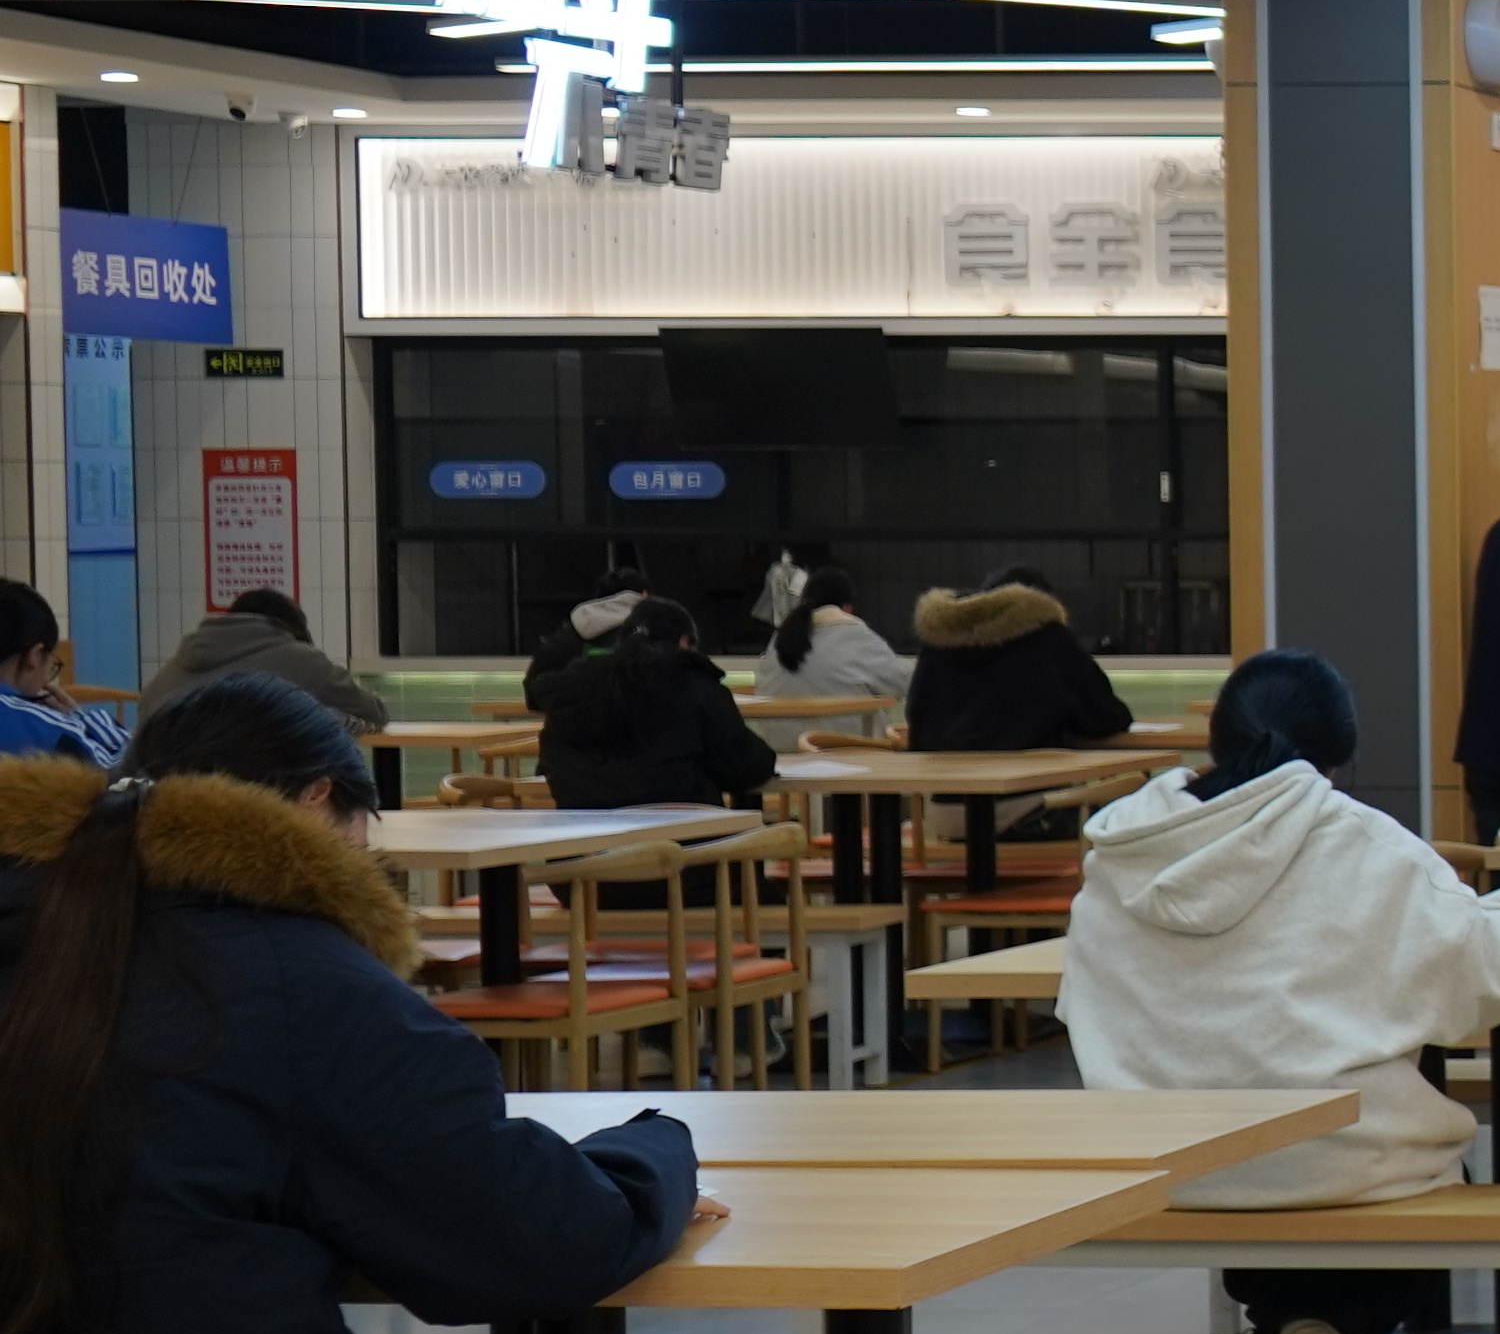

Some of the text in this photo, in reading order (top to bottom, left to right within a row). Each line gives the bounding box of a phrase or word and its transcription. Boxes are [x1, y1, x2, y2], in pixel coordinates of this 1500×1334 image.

[71, 249, 218, 307] 餐具回收处
